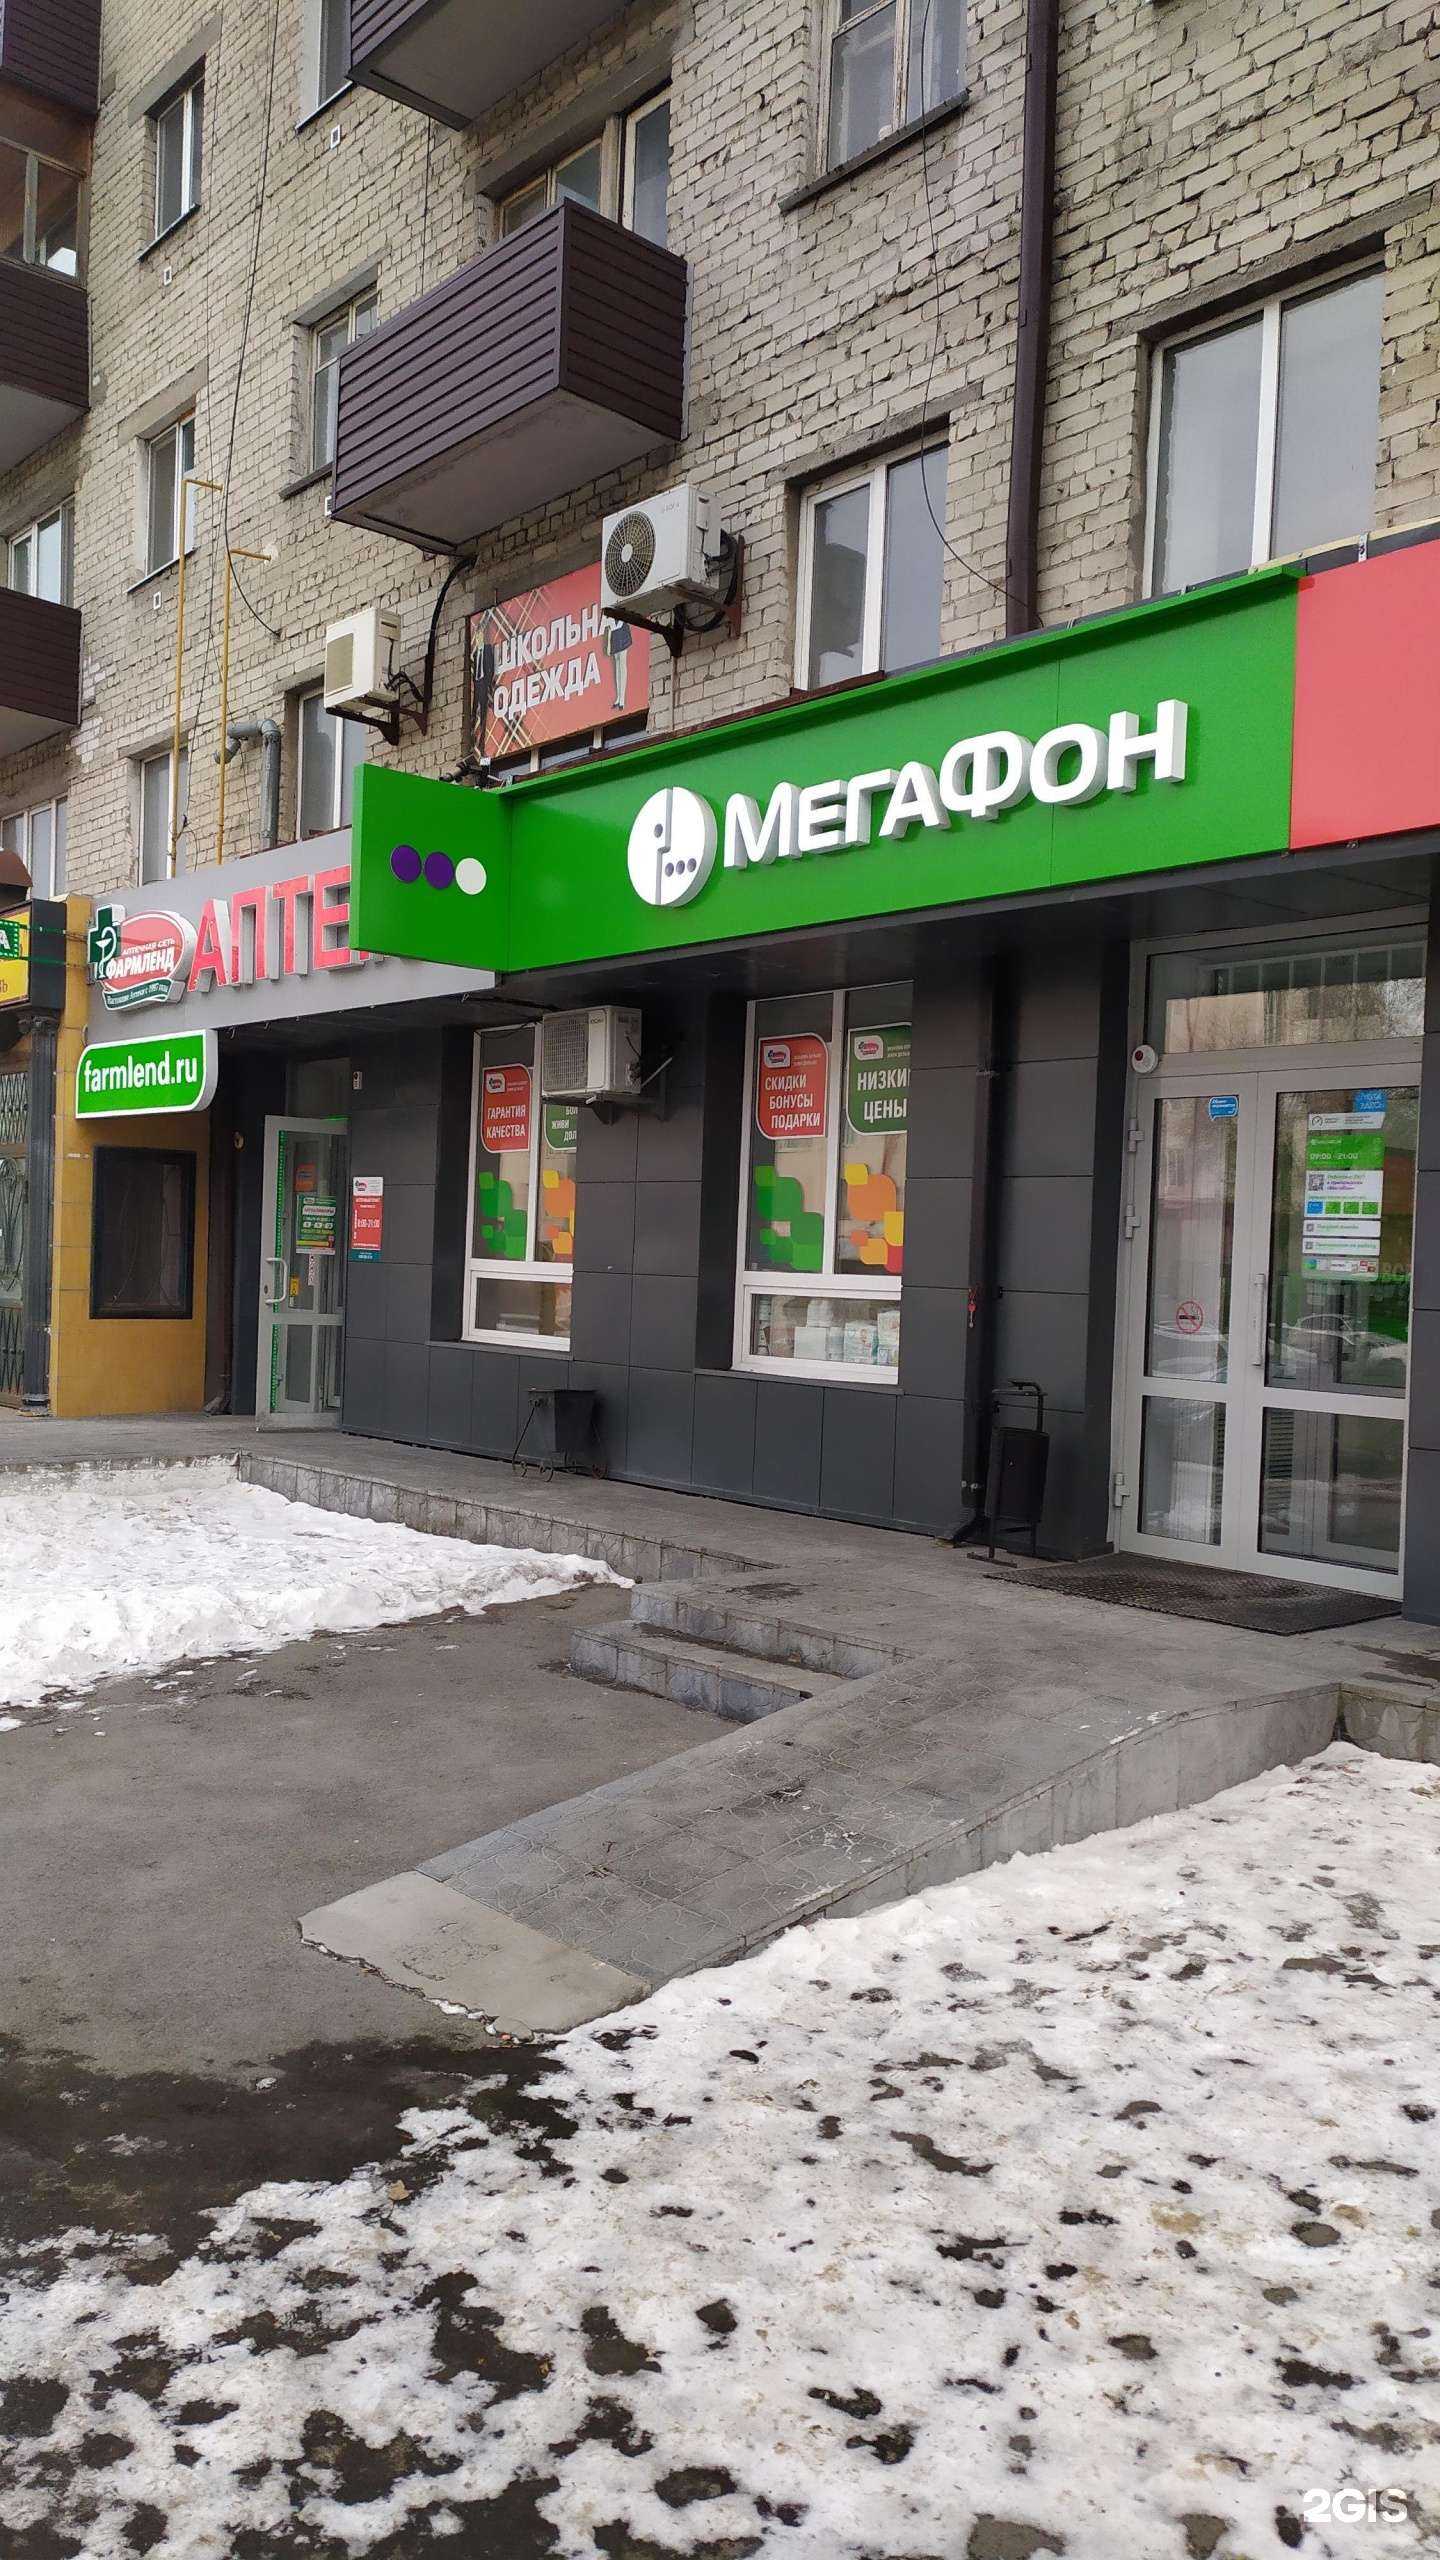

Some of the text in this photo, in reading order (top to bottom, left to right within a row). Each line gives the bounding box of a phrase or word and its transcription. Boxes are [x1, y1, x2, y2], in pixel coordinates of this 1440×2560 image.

[493, 652, 601, 720] ОДЕЖДА
[723, 698, 1187, 870] МЕГАФОН
[187, 864, 371, 993] АПТЕ
[106, 946, 175, 980] ФАРМЛЕНД
[84, 1051, 197, 1093] farmlend.ru
[765, 1073, 807, 1092] СКИДКИ
[487, 1104, 526, 1120] ГАРАНТИЯ
[769, 1093, 813, 1110] БОНУСЫ
[863, 1099, 908, 1123] ЦЕНЫ
[486, 1124, 526, 1139] КАЧЕСТВА
[771, 1112, 821, 1130] ПОДАРКИ
